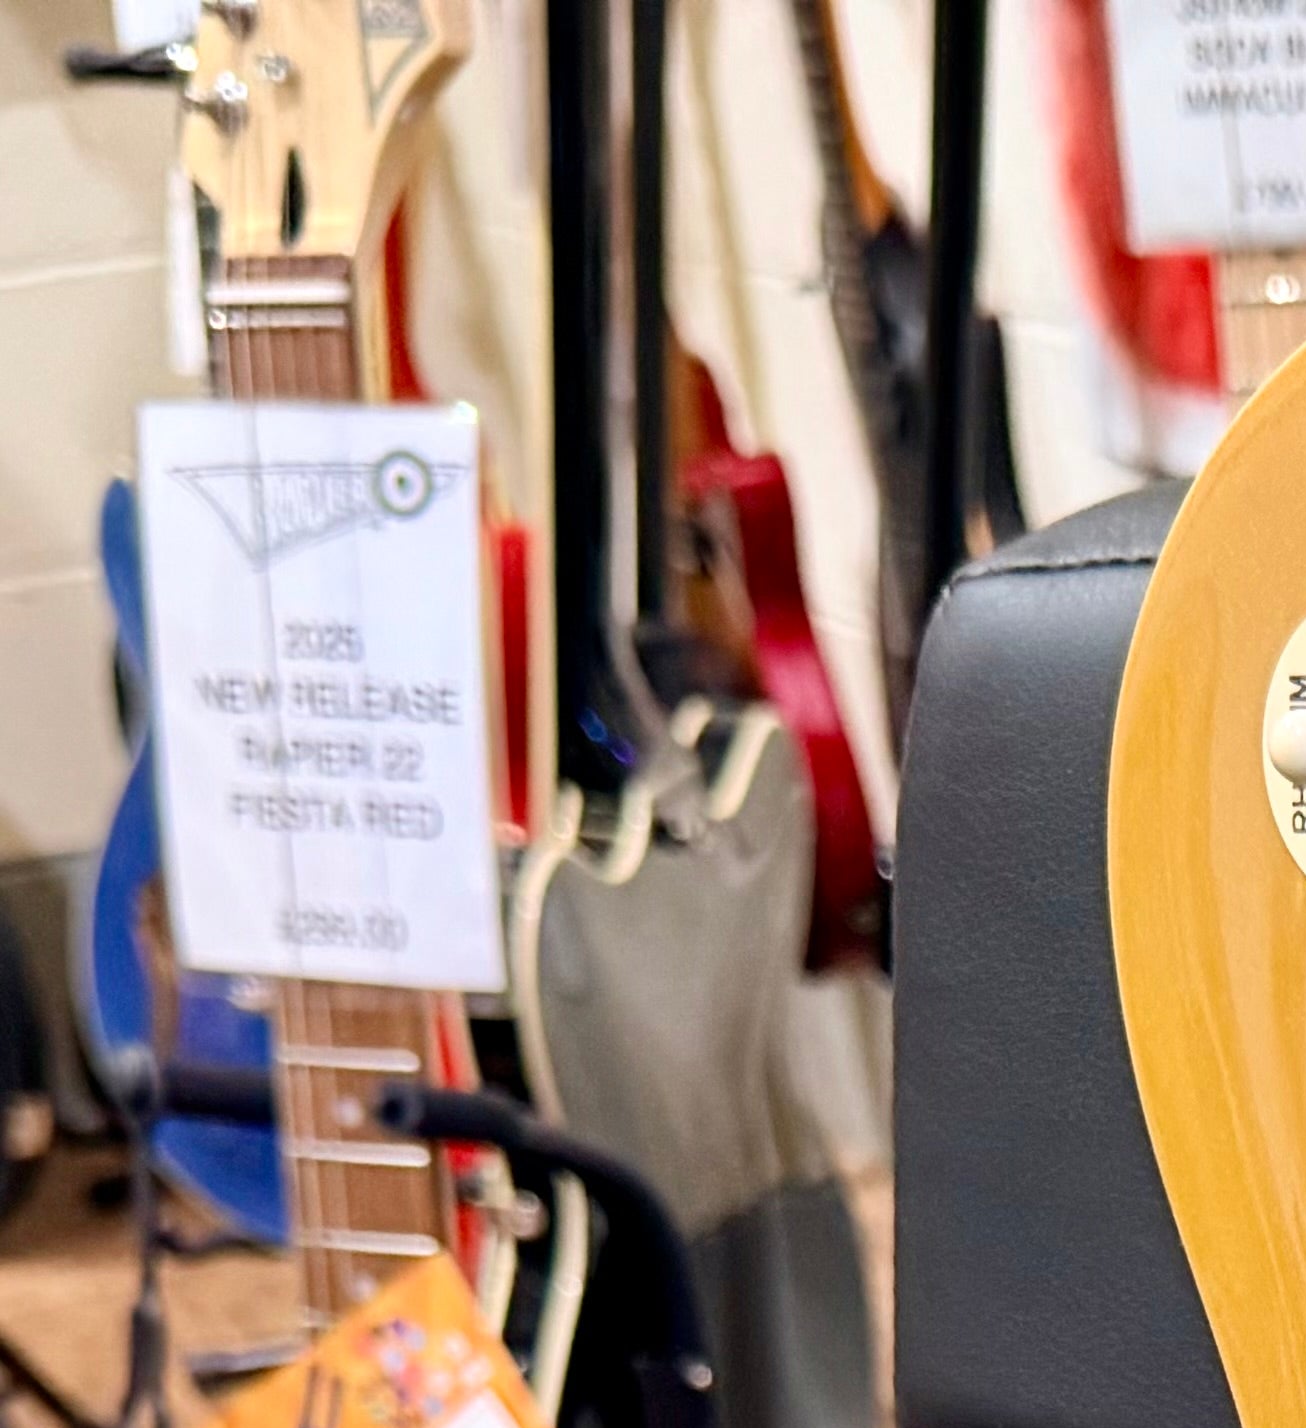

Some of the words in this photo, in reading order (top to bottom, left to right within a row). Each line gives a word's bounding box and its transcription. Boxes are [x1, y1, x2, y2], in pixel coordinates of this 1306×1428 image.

[284, 621, 364, 663] 2025
[195, 673, 279, 716] NEW
[291, 677, 463, 726] RELEASE
[236, 734, 375, 780] RAPIER
[382, 742, 425, 782] 22
[229, 792, 354, 834] FIESTA
[362, 797, 445, 841] RED
